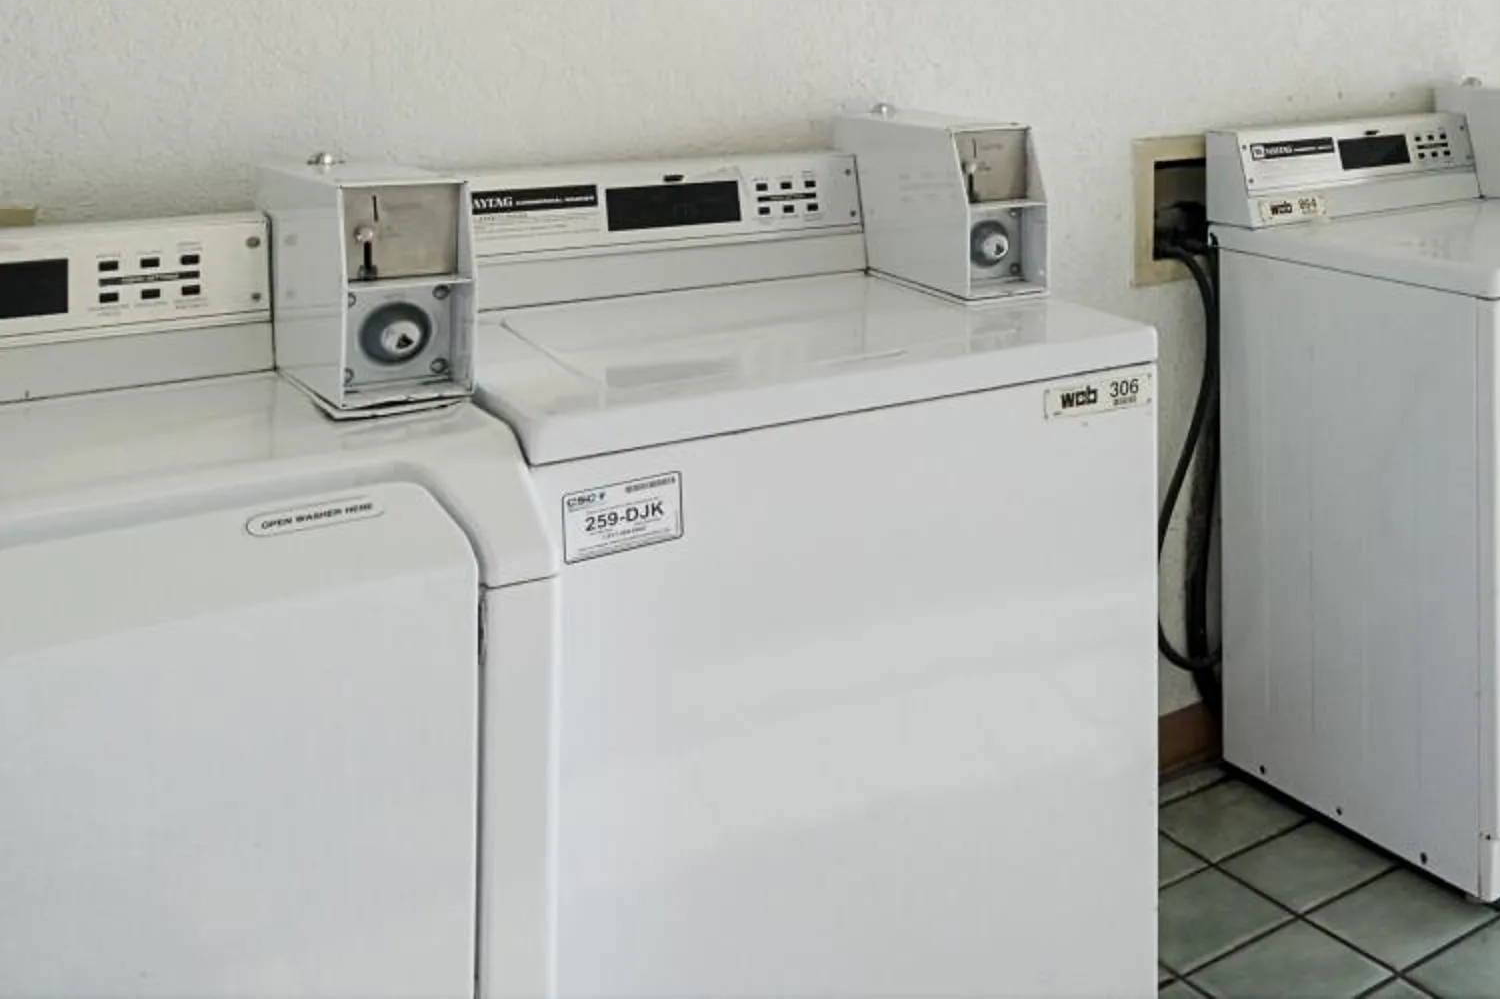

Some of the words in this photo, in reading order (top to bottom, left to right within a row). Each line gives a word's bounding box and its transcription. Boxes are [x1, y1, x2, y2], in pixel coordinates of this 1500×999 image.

[473, 196, 513, 210] AYTAG
[1109, 378, 1140, 398] 306
[260, 516, 293, 530] OPEN
[295, 507, 342, 523] WASHER
[584, 500, 665, 532] 259-DJK
